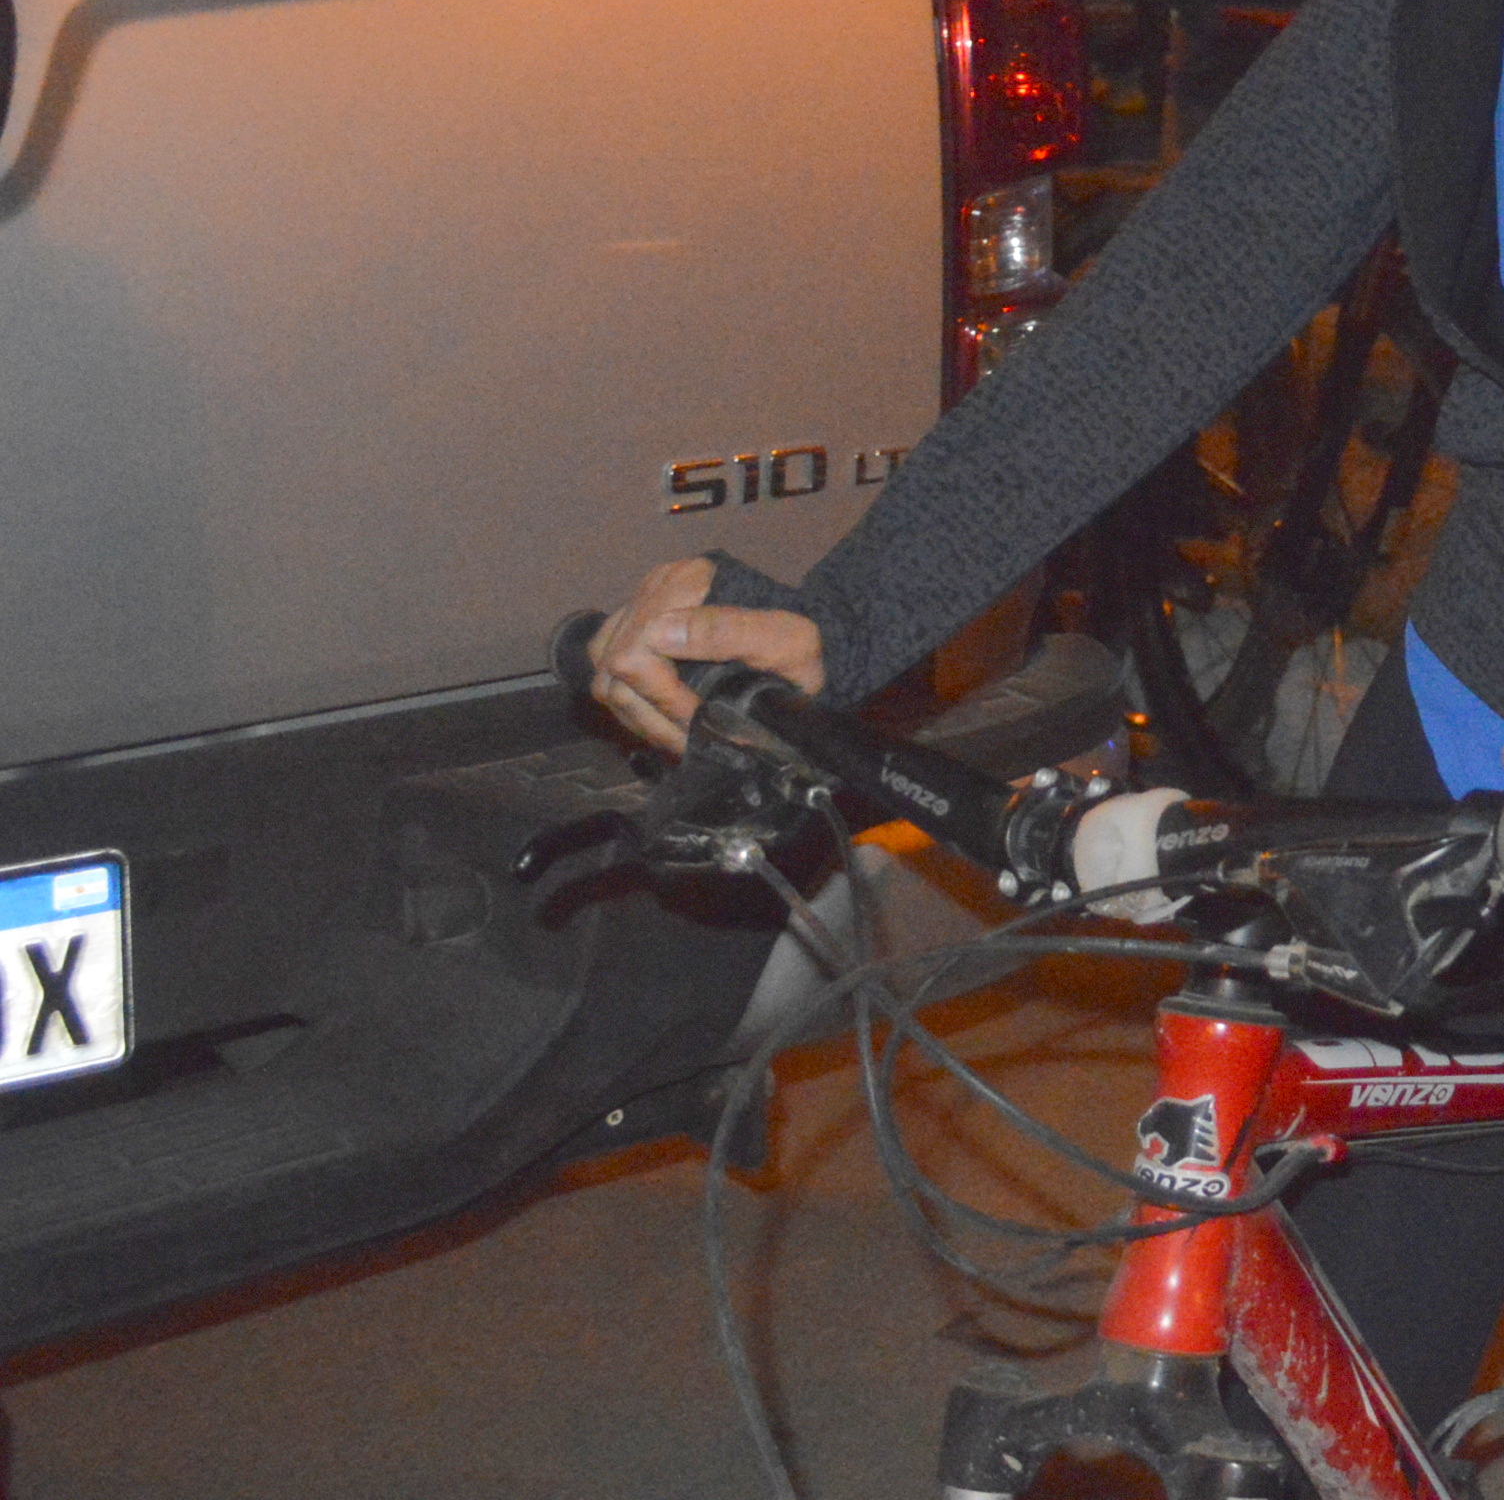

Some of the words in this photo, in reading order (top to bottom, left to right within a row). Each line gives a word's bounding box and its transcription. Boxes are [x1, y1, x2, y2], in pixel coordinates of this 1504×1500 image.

[663, 444, 828, 516] S10
[0, 934, 90, 1060] X
[1349, 1082, 1456, 1109] venzo
[1138, 1164, 1226, 1198] enzo
